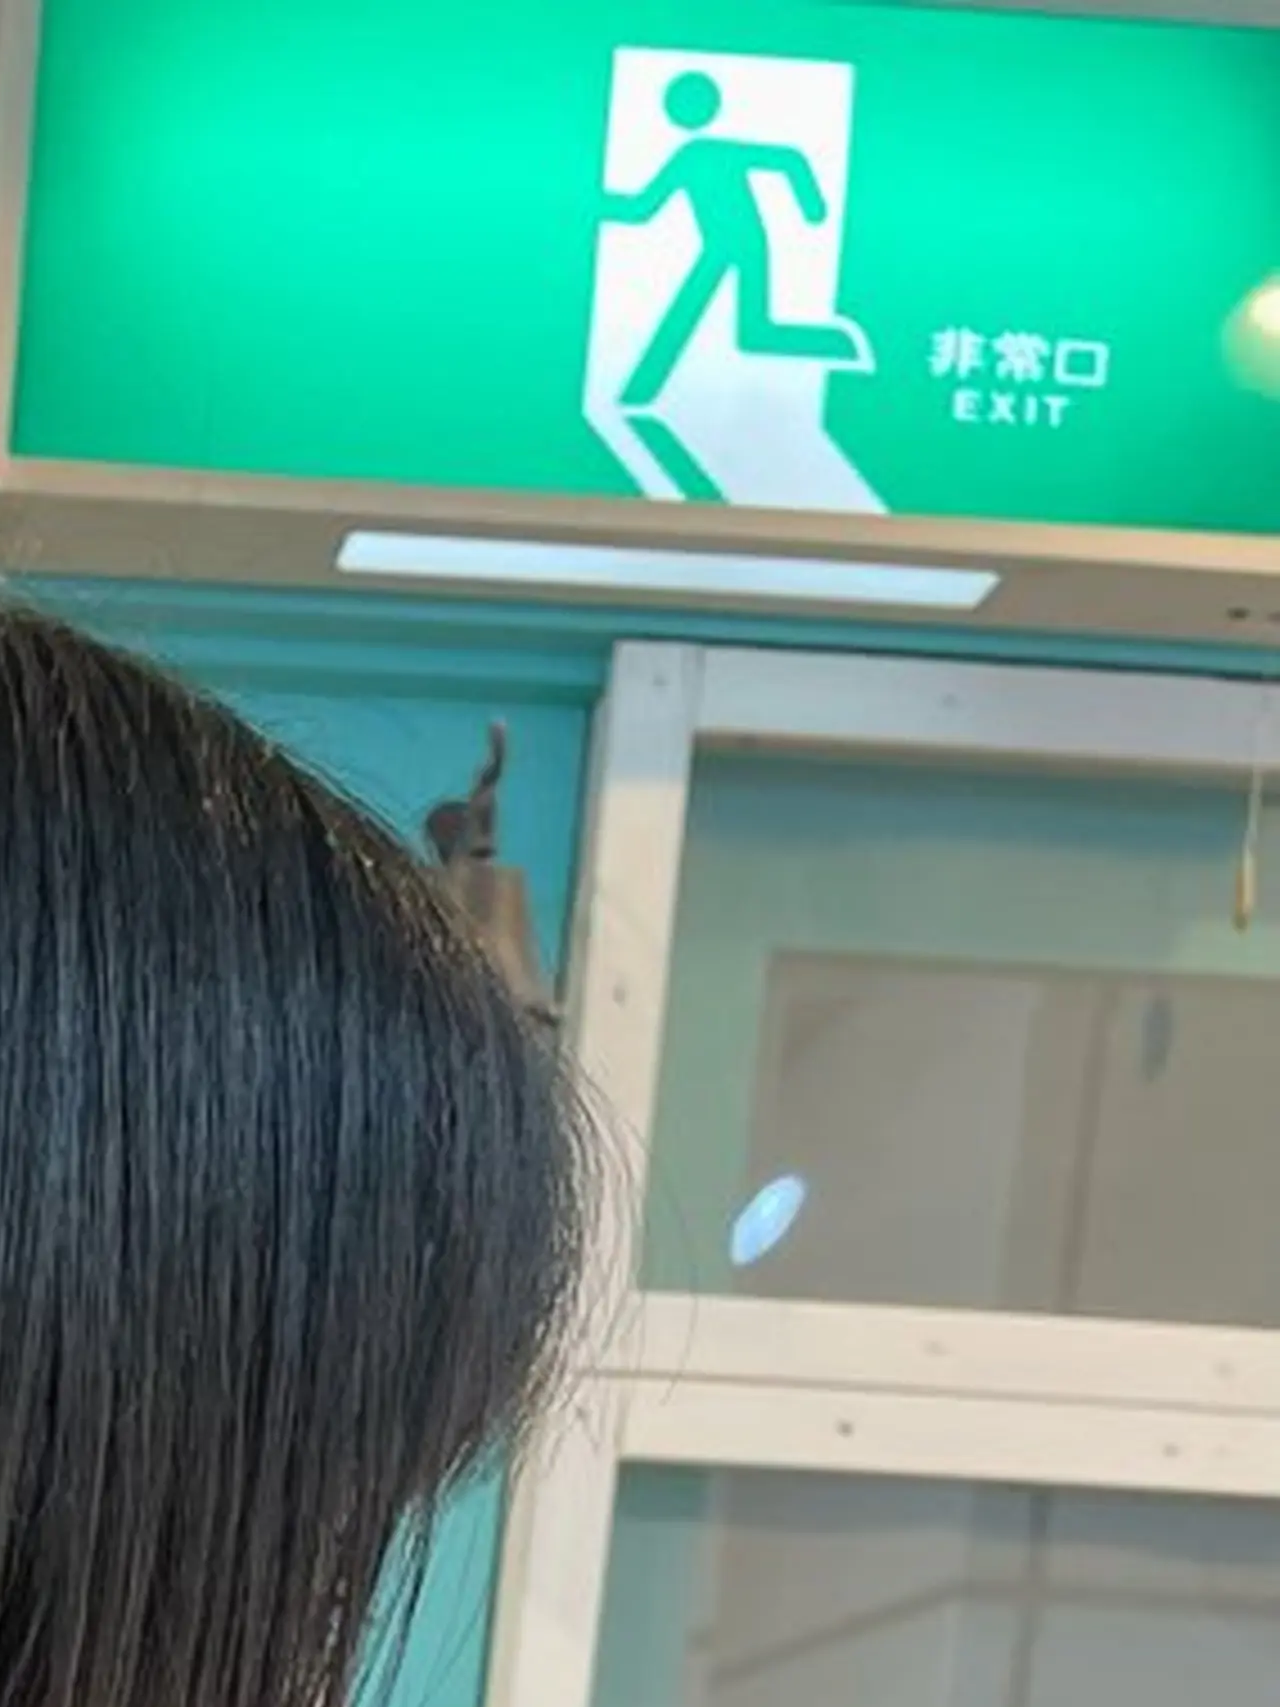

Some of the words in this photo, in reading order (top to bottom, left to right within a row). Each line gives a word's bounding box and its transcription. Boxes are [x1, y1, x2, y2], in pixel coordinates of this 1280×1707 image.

[927, 325, 1110, 388] 非常口
[952, 388, 1070, 428] EXIT
